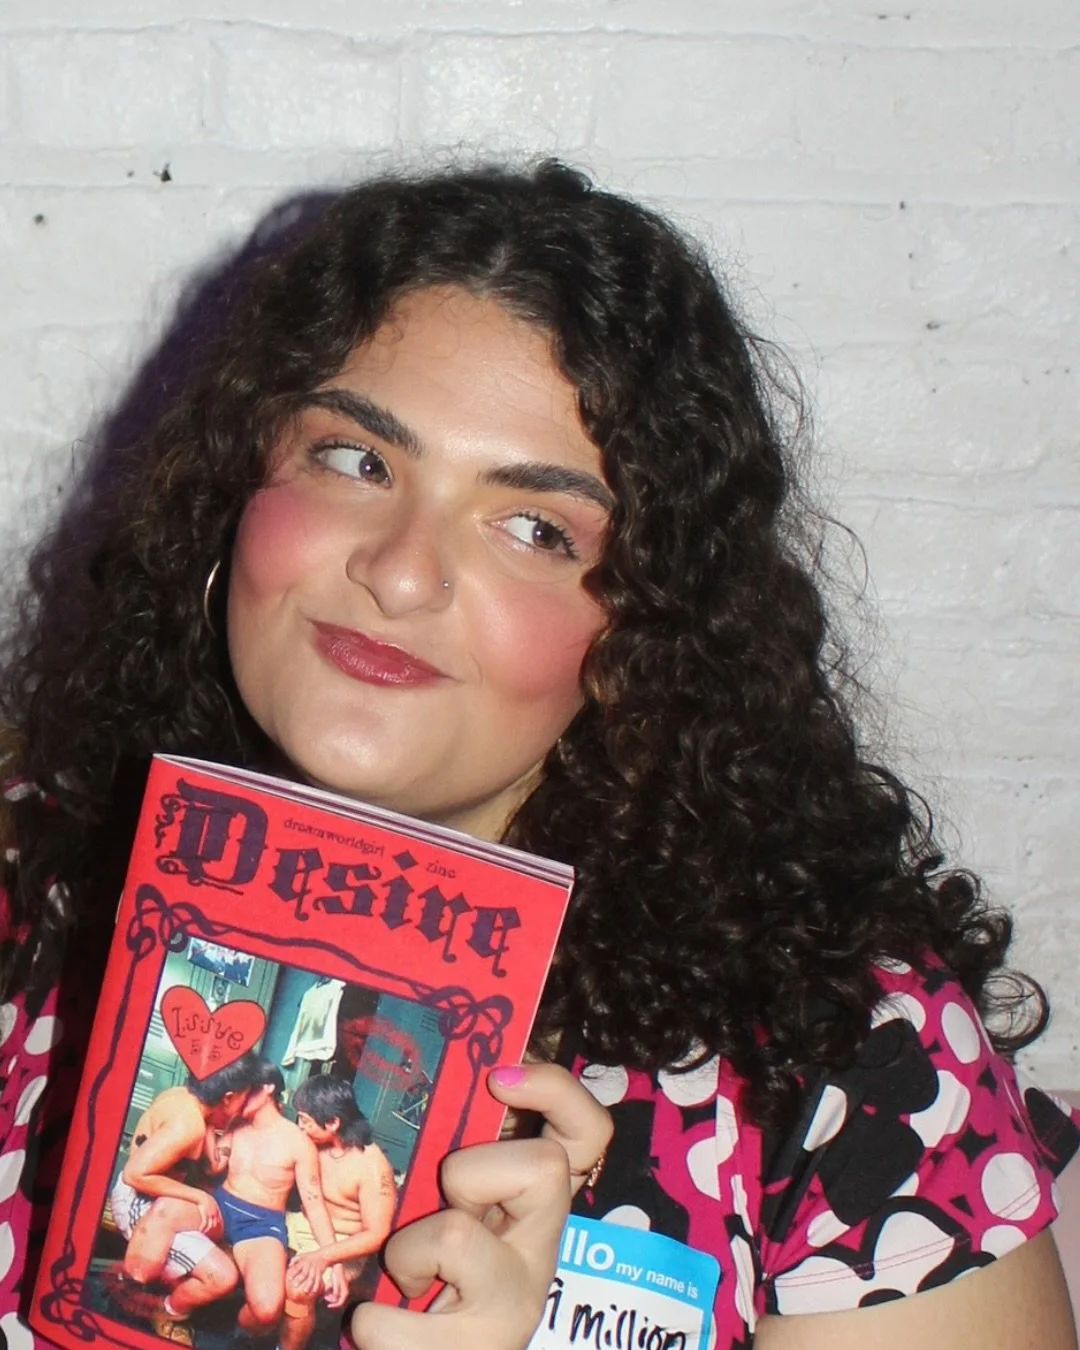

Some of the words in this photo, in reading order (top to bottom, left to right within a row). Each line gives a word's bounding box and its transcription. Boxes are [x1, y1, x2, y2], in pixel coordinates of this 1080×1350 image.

[155, 778, 521, 978] Desire
[283, 816, 385, 857] dreamworldgirl
[424, 860, 457, 880] zine
[171, 1006, 245, 1050] Issue
[561, 1226, 616, 1271] llo
[615, 1263, 644, 1281] my
[646, 1270, 686, 1294] name
[687, 1281, 699, 1299] is
